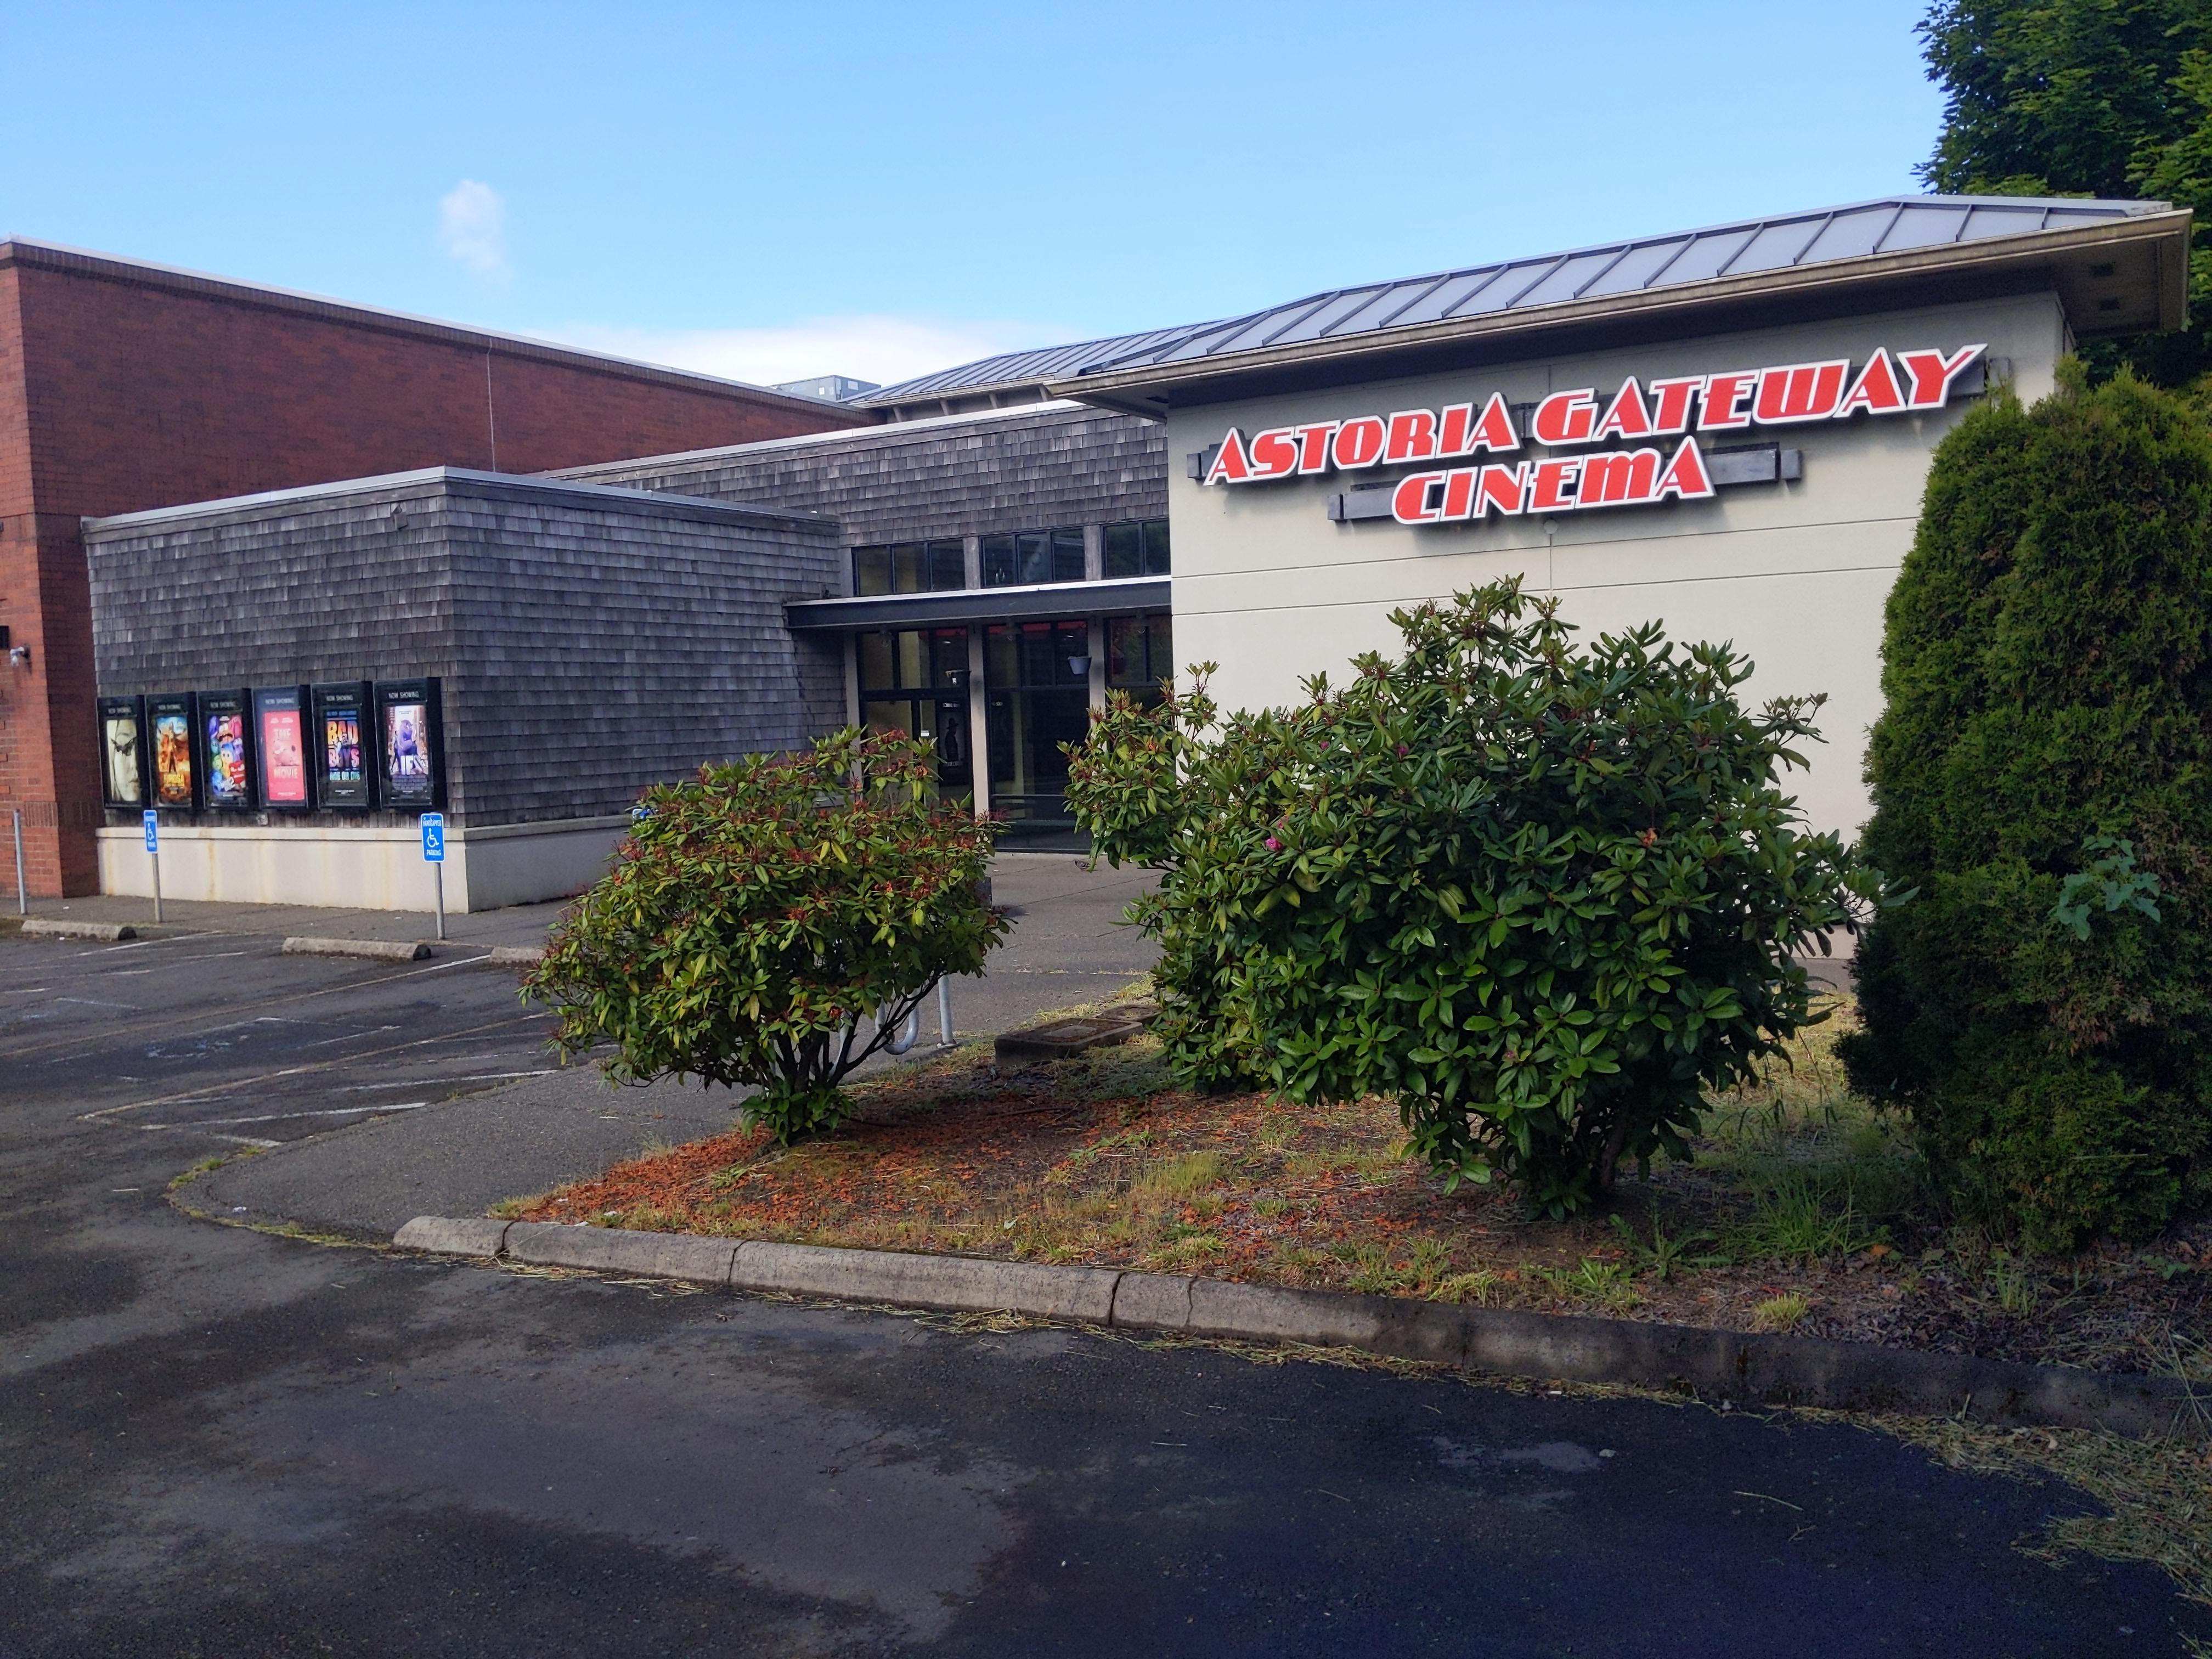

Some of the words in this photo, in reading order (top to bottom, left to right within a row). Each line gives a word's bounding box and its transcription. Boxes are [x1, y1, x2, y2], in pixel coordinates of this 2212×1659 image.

[1203, 391, 1522, 486] ASTORIA
[1532, 343, 1988, 446] GATEWAY
[1391, 435, 1717, 524] CINEMA
[273, 728, 291, 741] THE
[327, 720, 358, 745] BAD
[328, 748, 360, 768] BOYS
[400, 755, 415, 775] IF
[274, 768, 298, 778] MOVIE
